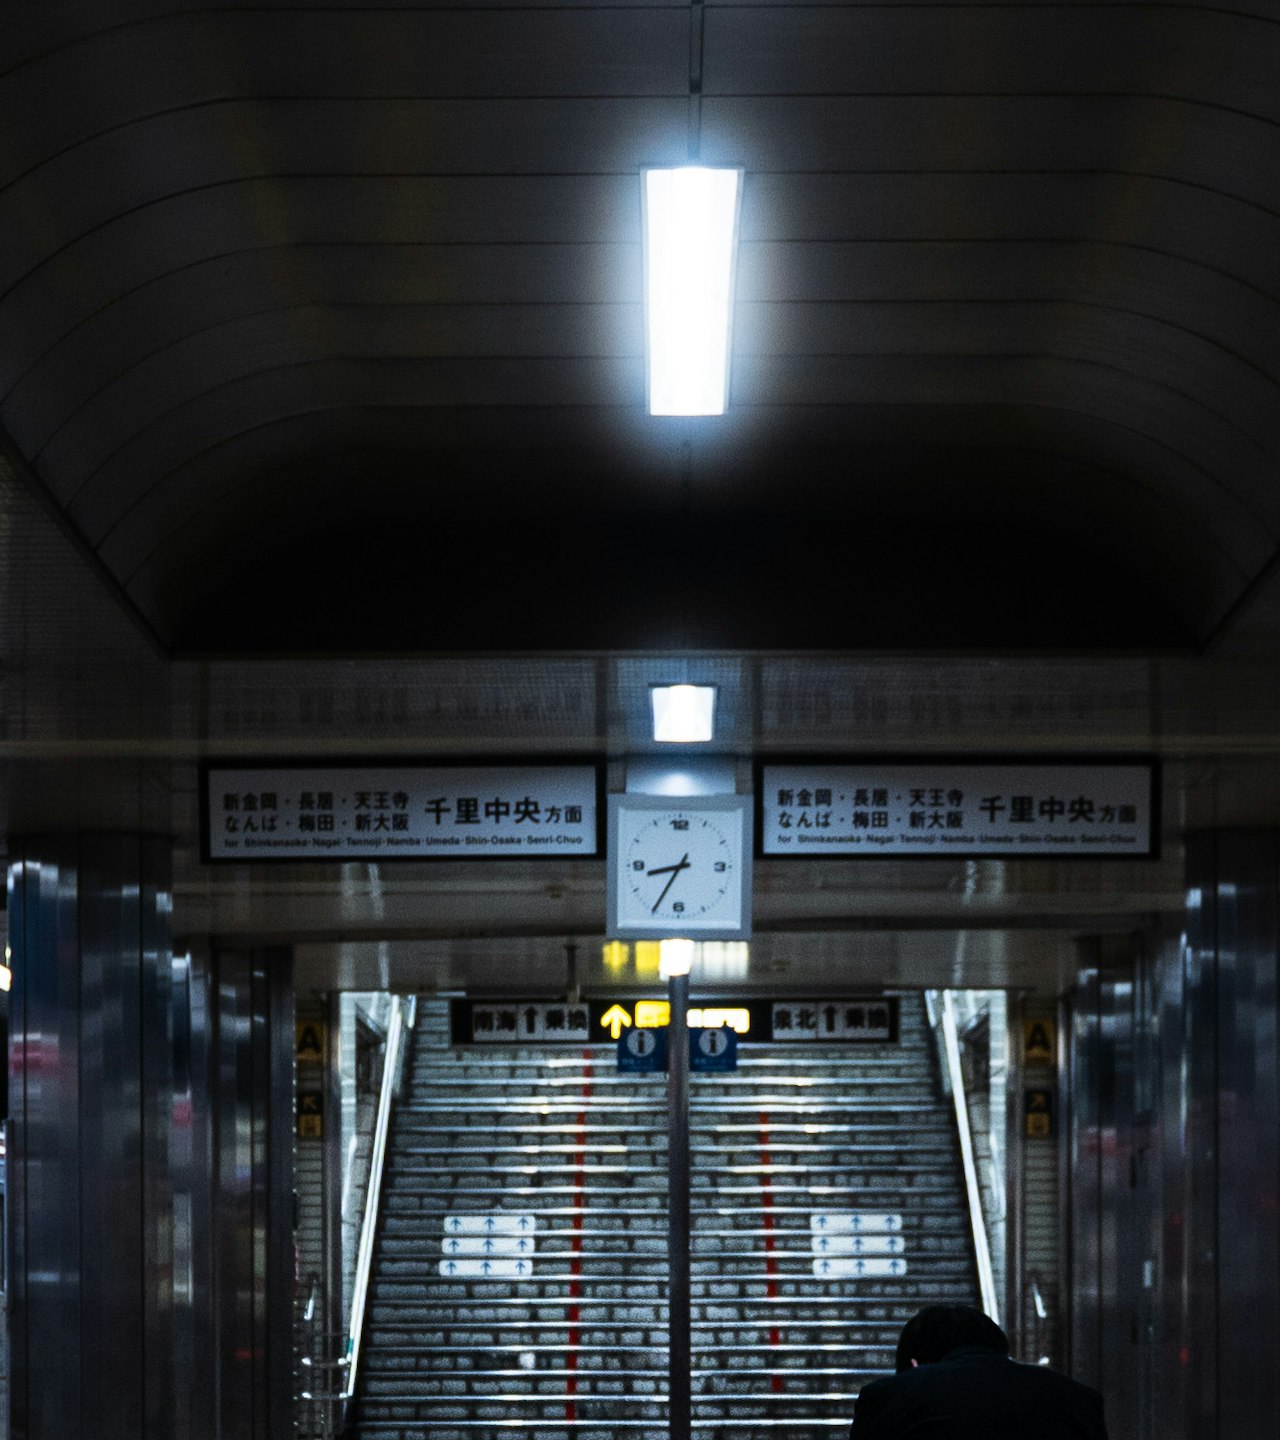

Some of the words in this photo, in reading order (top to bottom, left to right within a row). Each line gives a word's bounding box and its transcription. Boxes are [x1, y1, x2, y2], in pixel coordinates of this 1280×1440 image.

[670, 820, 689, 831] 12
[224, 838, 238, 848] for
[633, 860, 644, 871] 9
[714, 862, 726, 872] 3
[673, 902, 684, 912] 6
